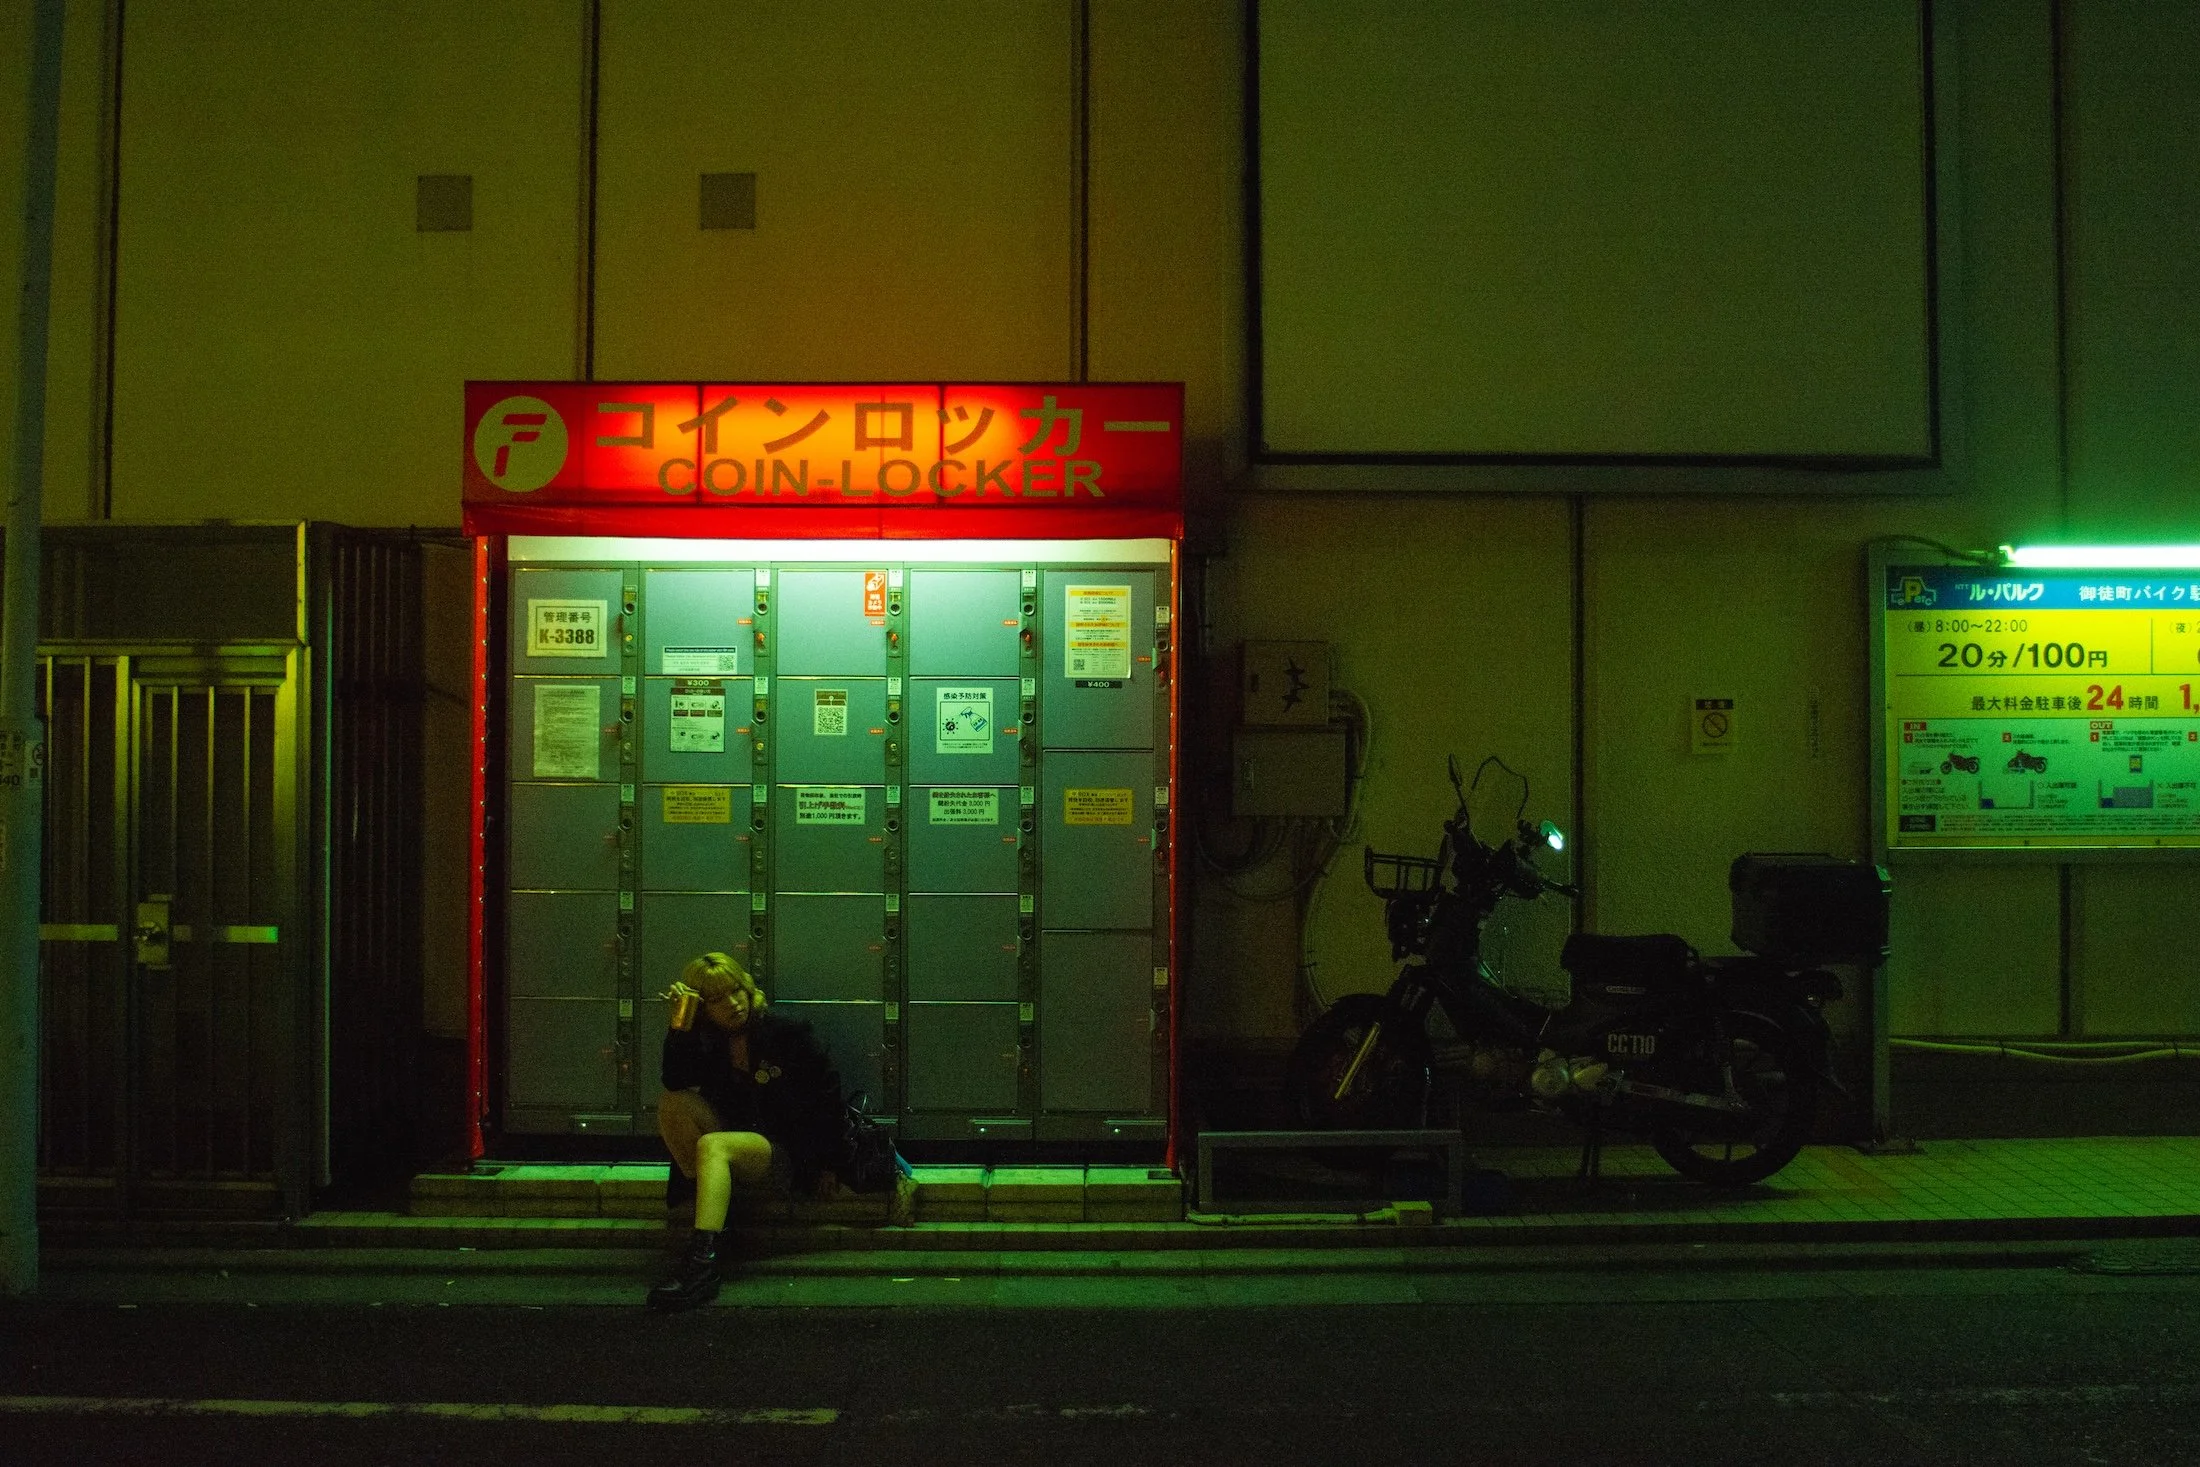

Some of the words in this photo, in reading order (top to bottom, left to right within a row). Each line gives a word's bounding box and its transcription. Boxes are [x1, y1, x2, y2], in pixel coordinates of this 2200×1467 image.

[597, 395, 1170, 457] コインロッカー
[658, 457, 1106, 498] COIN-LOCKER
[543, 611, 592, 624] 管理番号
[539, 629, 595, 645] K-3388
[687, 679, 710, 687] ¥300
[943, 692, 987, 700] 感染予防対策
